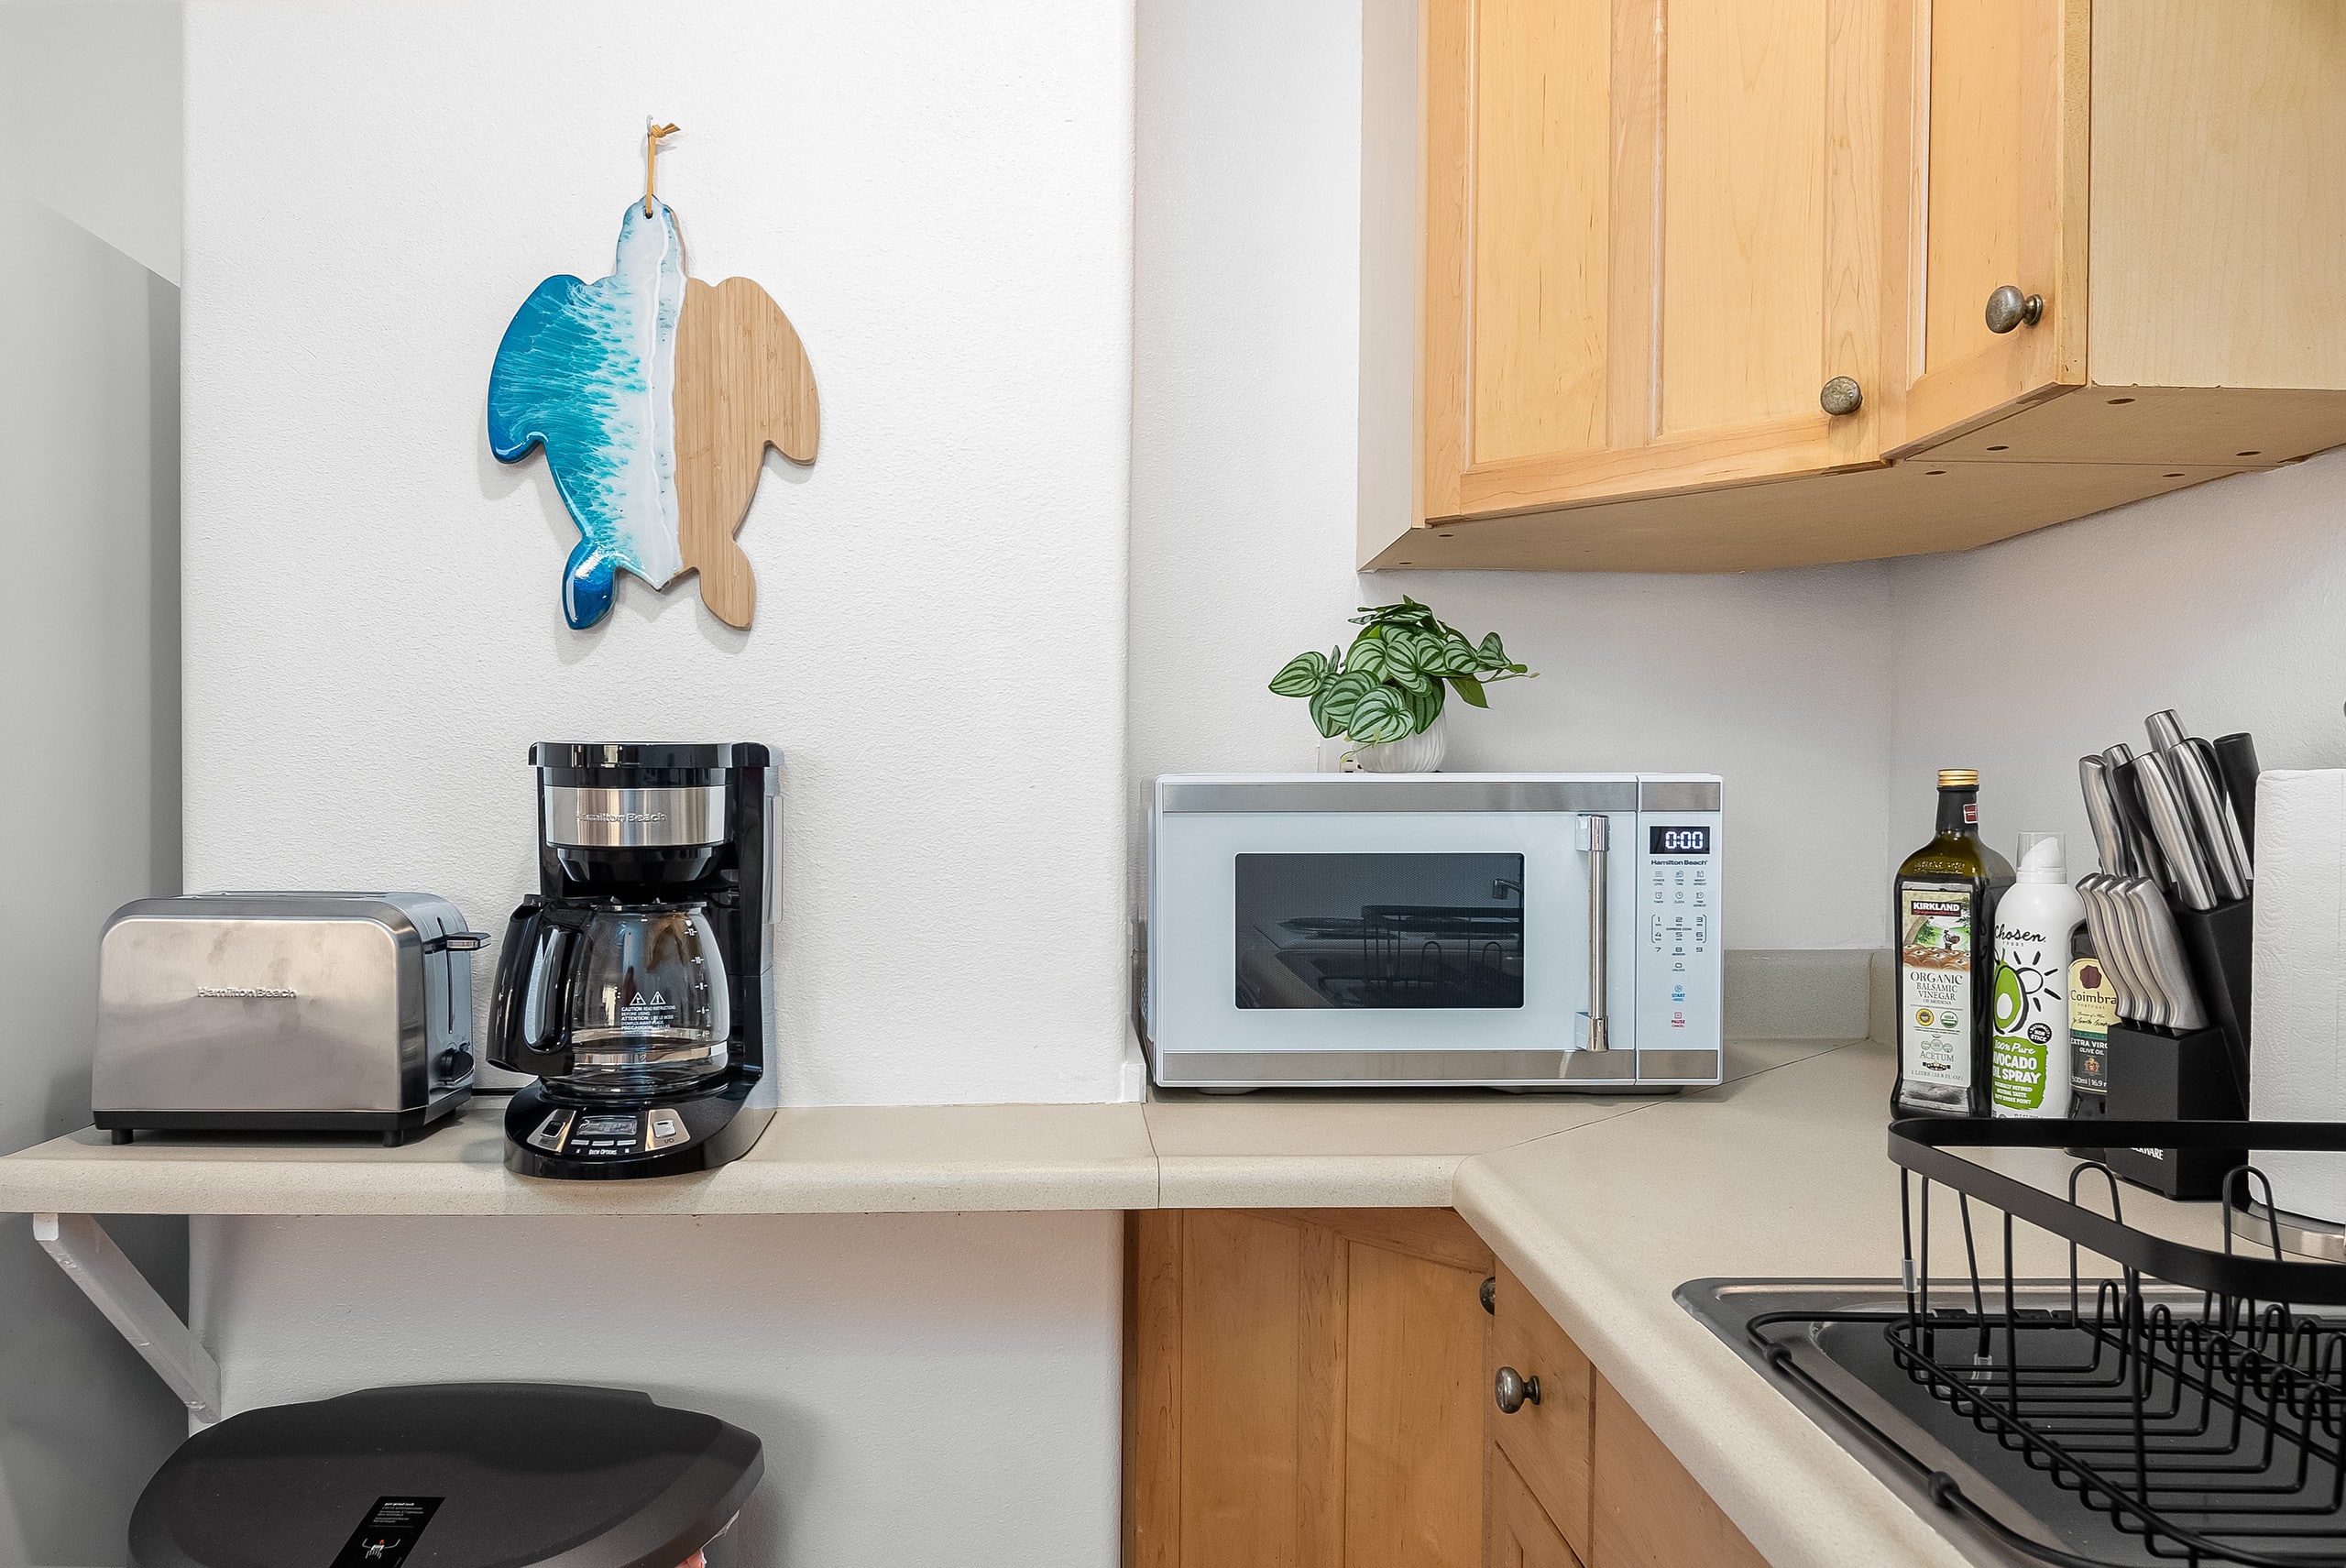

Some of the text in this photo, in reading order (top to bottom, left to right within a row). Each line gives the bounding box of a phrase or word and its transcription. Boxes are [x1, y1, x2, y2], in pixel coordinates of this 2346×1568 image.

[576, 811, 667, 823] Hamilton Beach
[1665, 831, 1704, 850] 0:00
[1913, 902, 1960, 912] KIRKLAND
[1910, 971, 1963, 985] ORGANIC
[196, 986, 297, 999] Hamilton Beach
[1916, 982, 1958, 993] BALSAMIC
[1918, 991, 1956, 1001] VINEGAR
[2071, 990, 2117, 1005] Coimbra
[2031, 1034, 2047, 1042] STICK
[2071, 1037, 2089, 1047] EXTRA
[2011, 1043, 2036, 1054] Pure
[2079, 1047, 2095, 1055] OLIVE
[1919, 1050, 1955, 1062] ACETUM
[2001, 1068, 2042, 1084] SPRAY
[2091, 1079, 2102, 1087] 16.9
